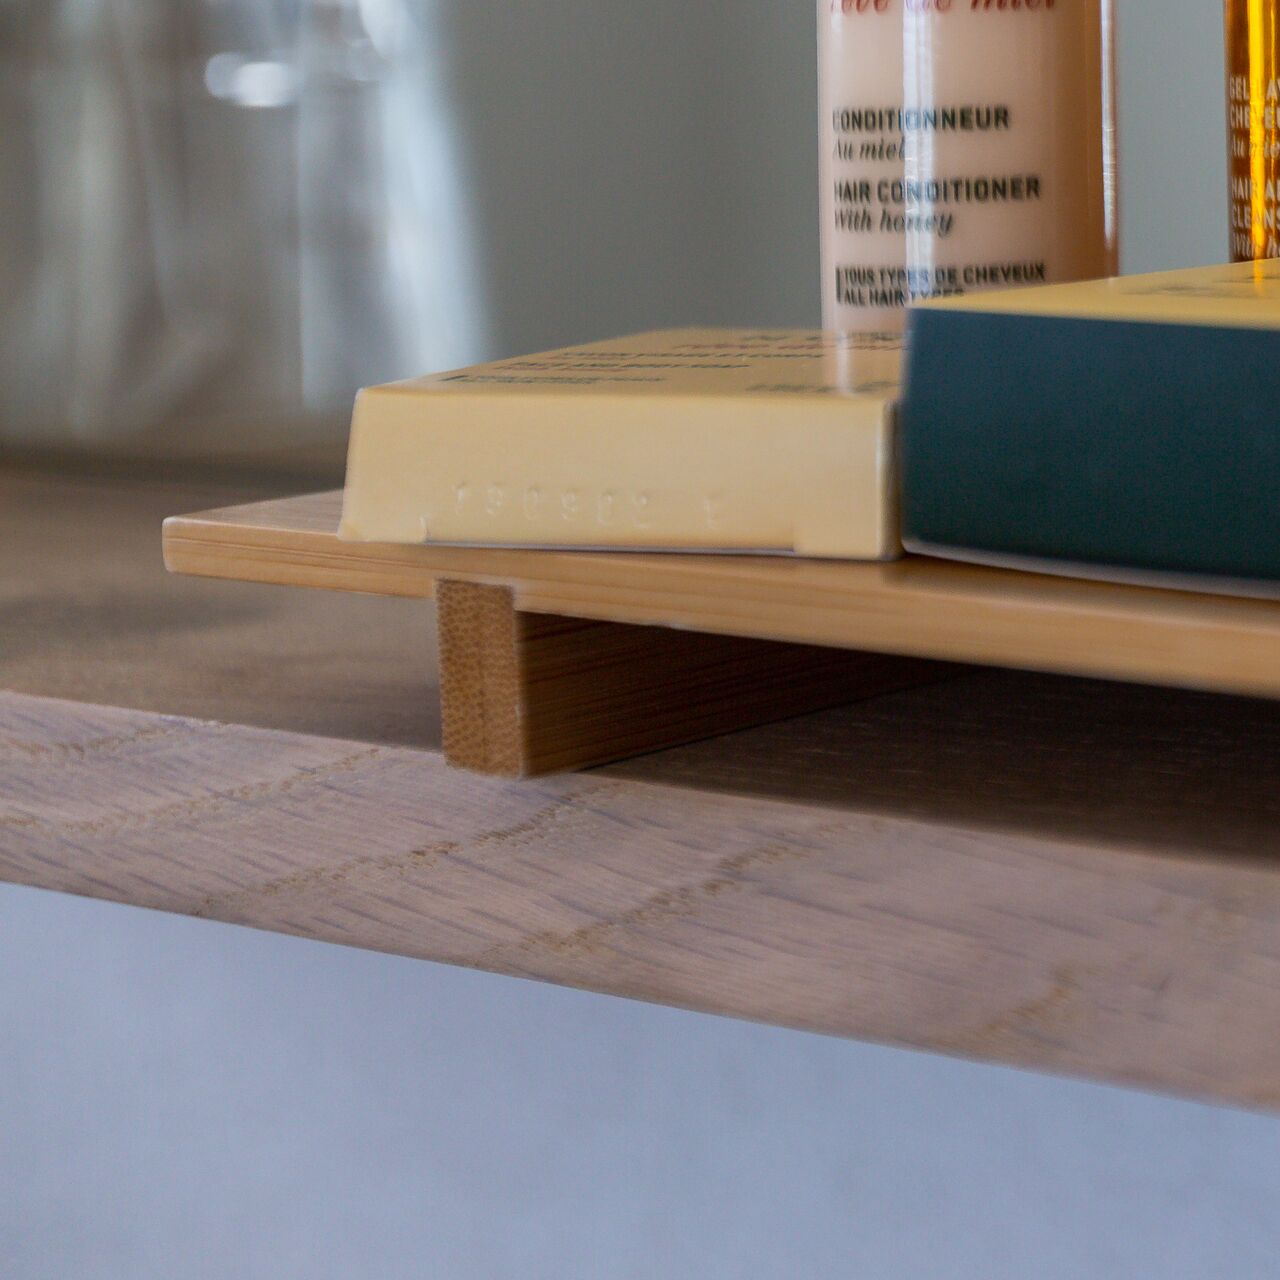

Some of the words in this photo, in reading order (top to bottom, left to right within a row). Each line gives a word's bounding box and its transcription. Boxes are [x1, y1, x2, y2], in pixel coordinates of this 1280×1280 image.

[832, 103, 1010, 132] CONDITIONNEUR
[860, 136, 906, 161] miel
[834, 177, 870, 204] HAIR
[877, 173, 1041, 203] CONDITIONER
[1231, 177, 1258, 202] HAI
[835, 208, 872, 233] With
[880, 208, 954, 237] honey
[963, 262, 1046, 284] CHEVEUX
